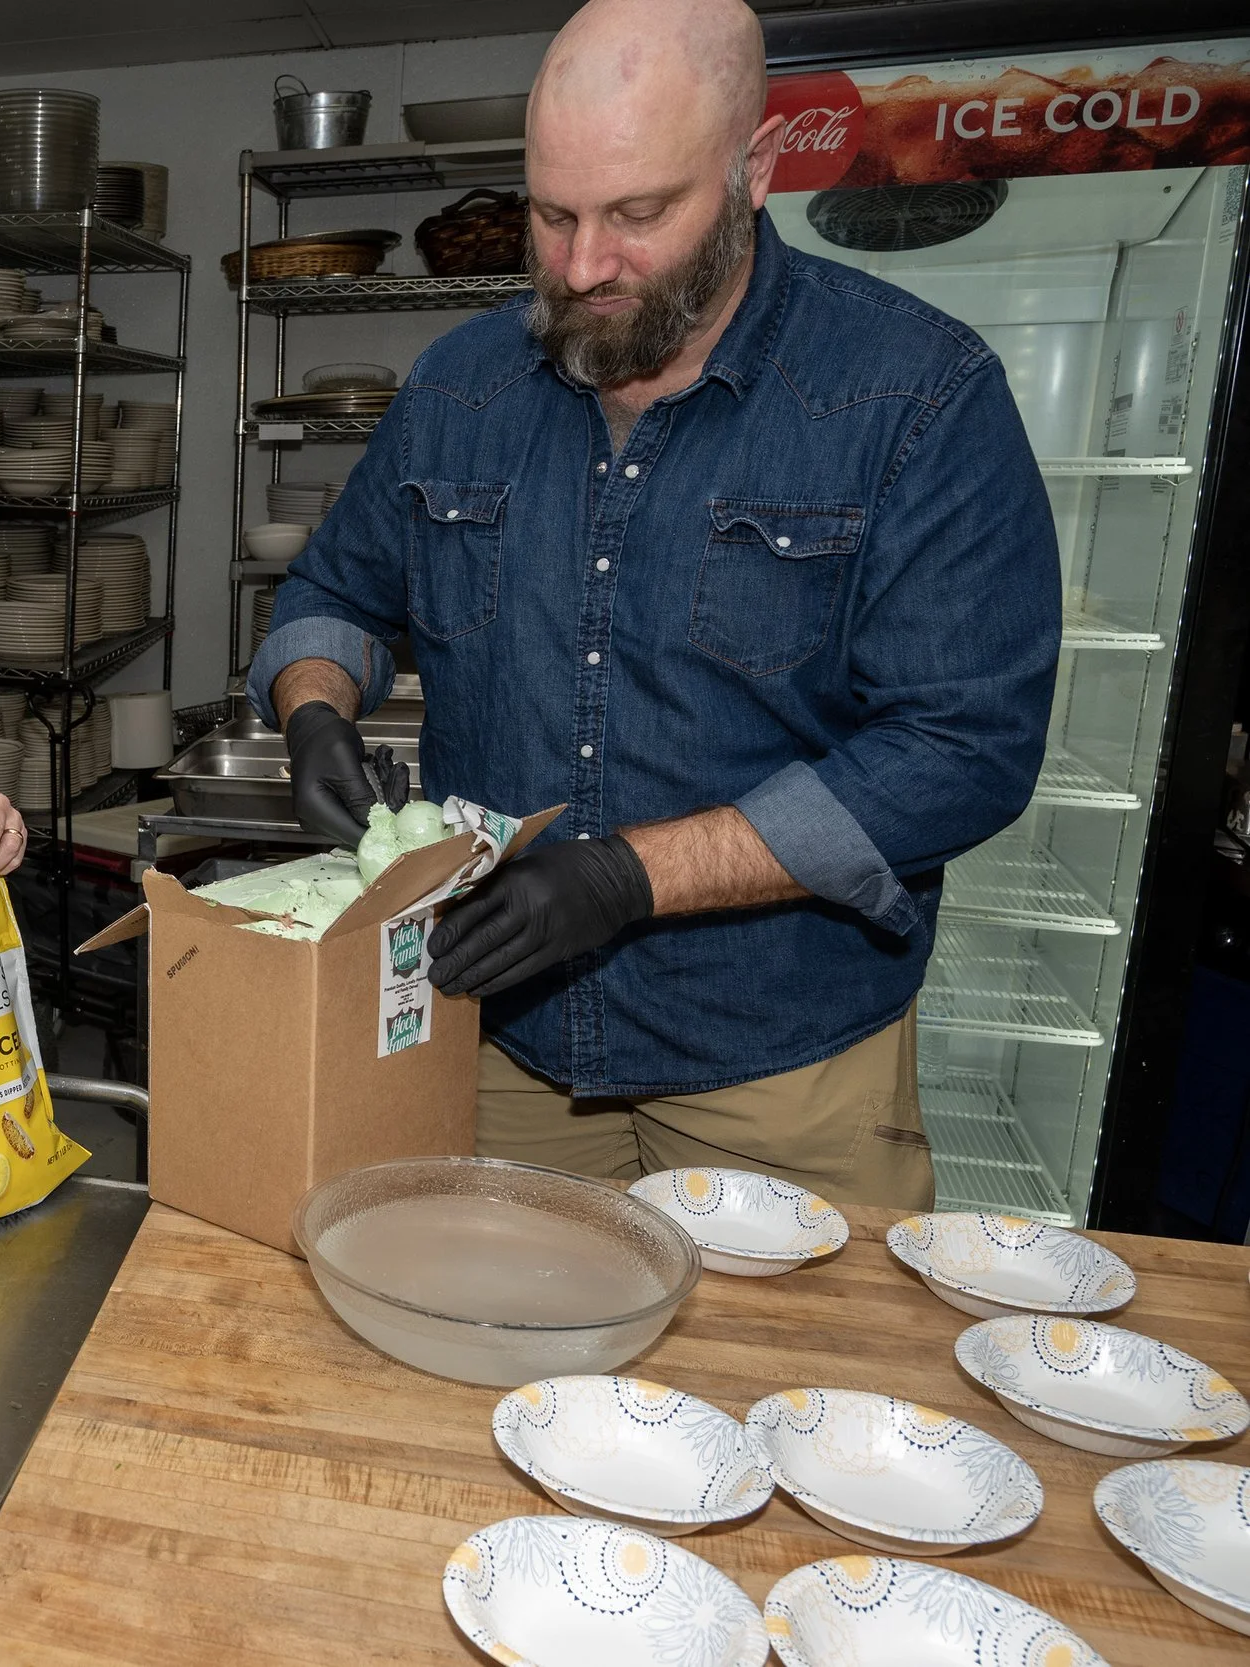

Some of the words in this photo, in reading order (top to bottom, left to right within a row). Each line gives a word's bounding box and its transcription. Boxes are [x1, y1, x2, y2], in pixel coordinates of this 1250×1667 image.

[779, 105, 859, 153] Cola
[935, 97, 1024, 141] ICE
[1045, 85, 1201, 134] COLD
[166, 944, 200, 979] SPUMONI
[4, 1084, 23, 1096] DIPPED
